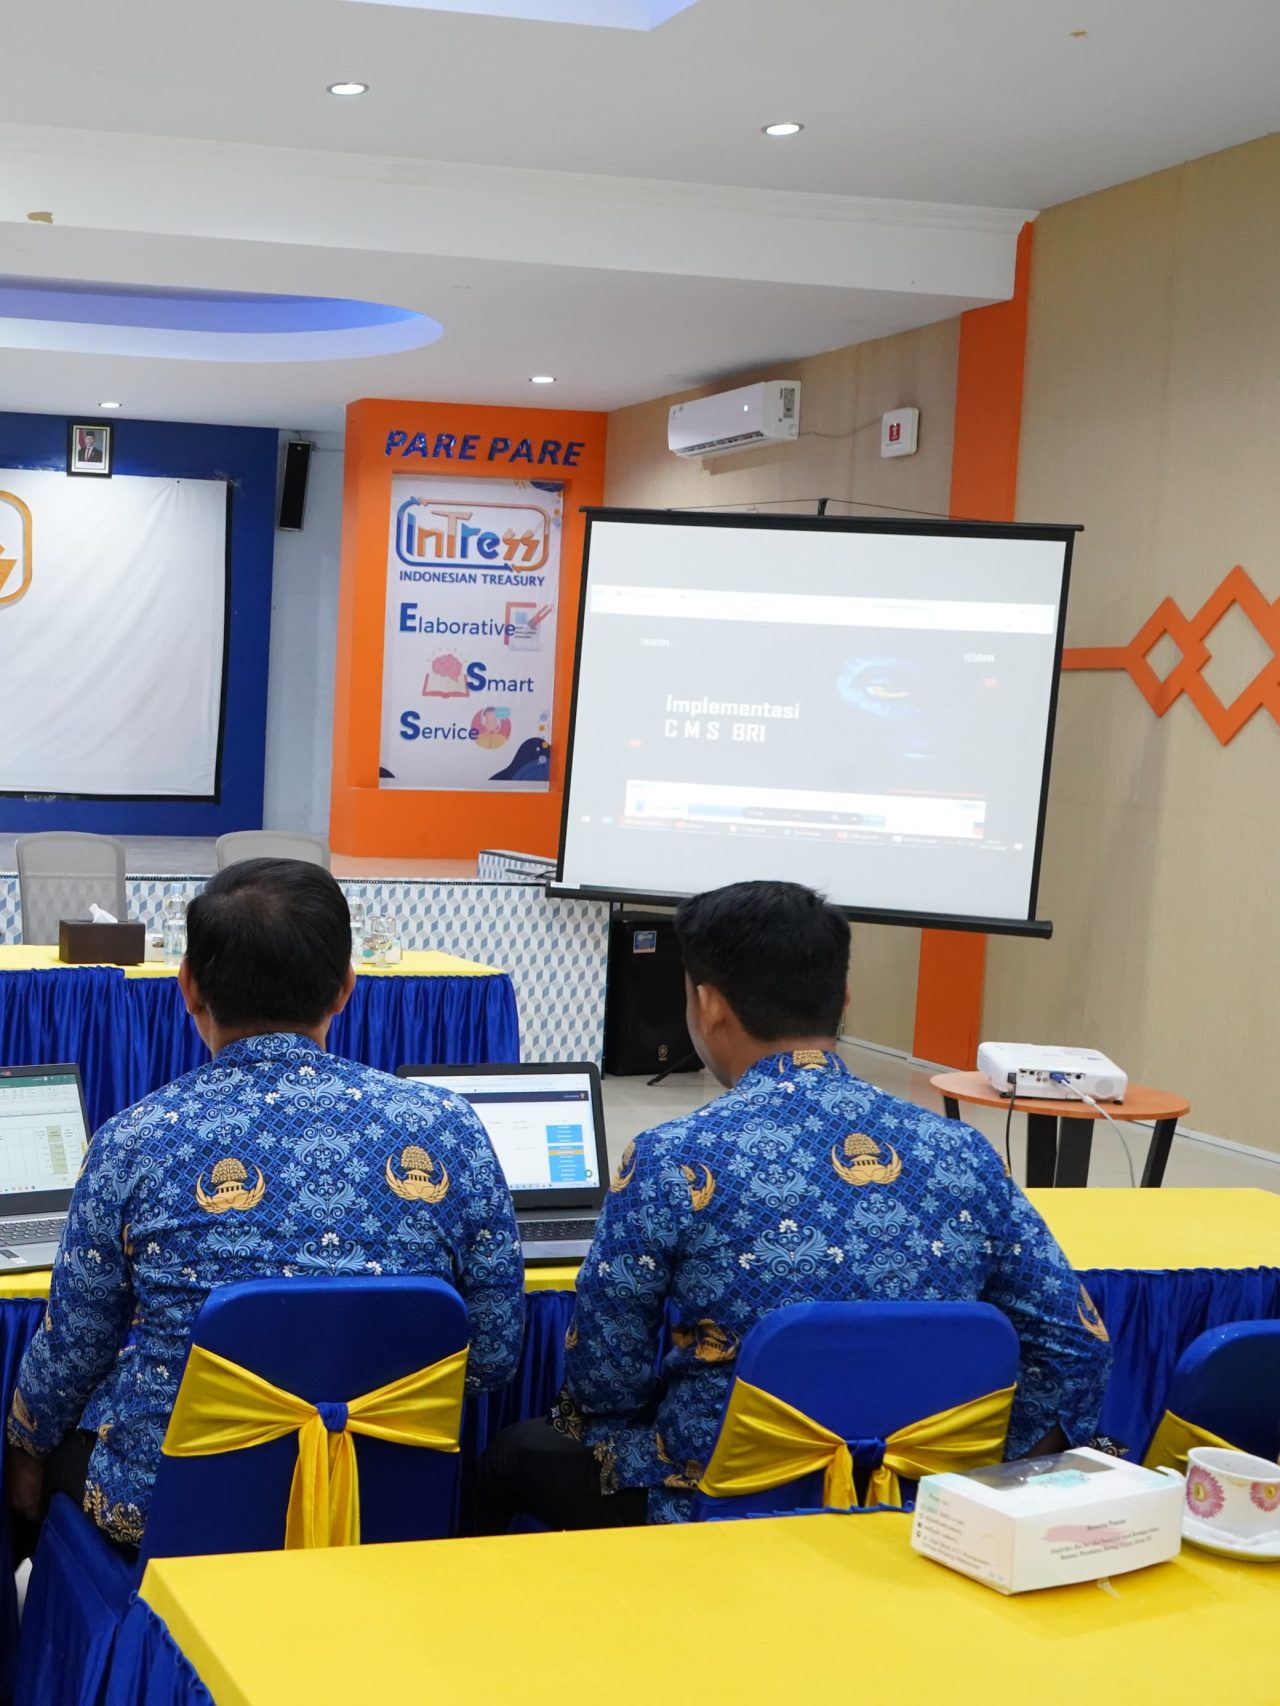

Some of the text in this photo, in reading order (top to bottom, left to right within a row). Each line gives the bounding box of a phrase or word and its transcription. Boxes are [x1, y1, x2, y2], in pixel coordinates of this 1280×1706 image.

[384, 430, 585, 467] PARE PARE
[406, 510, 540, 561] InTress
[400, 570, 545, 588] INDONESIAN TREASURY
[400, 602, 516, 637] Elaborative
[466, 661, 534, 692] Smart
[666, 694, 801, 720] Implementasi
[400, 710, 480, 742] Service
[732, 723, 766, 743] BRI
